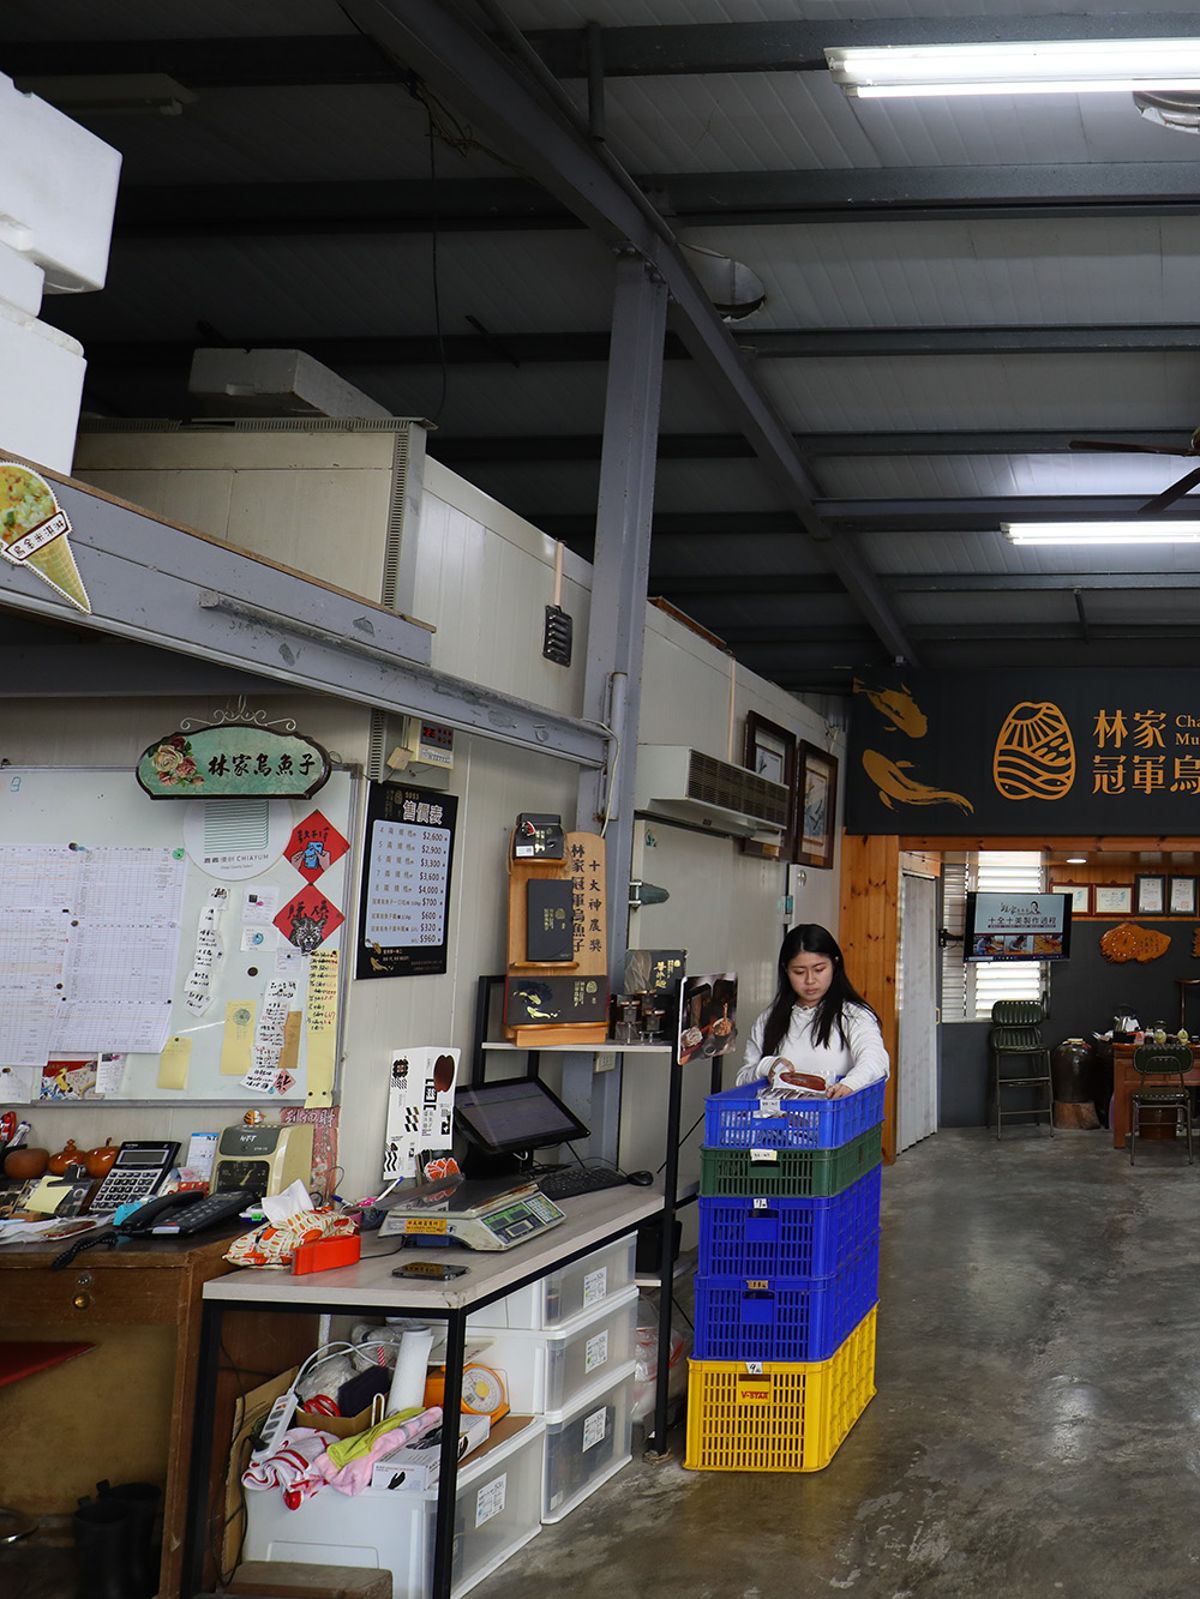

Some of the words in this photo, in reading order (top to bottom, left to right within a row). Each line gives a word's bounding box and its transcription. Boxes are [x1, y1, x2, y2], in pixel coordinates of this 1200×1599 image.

[1092, 709, 1168, 749] 林家
[208, 752, 317, 778] 林家烏魚子
[403, 799, 444, 825] 售價表
[422, 831, 443, 842] $2,600
[421, 845, 441, 854] $2,900
[420, 858, 440, 868] $3,300
[419, 871, 440, 881] $3,600
[418, 884, 438, 895] $4,000
[422, 898, 437, 906] $700
[588, 860, 602, 953] 十大神農獎
[421, 911, 436, 920] $600
[420, 923, 436, 932] $320
